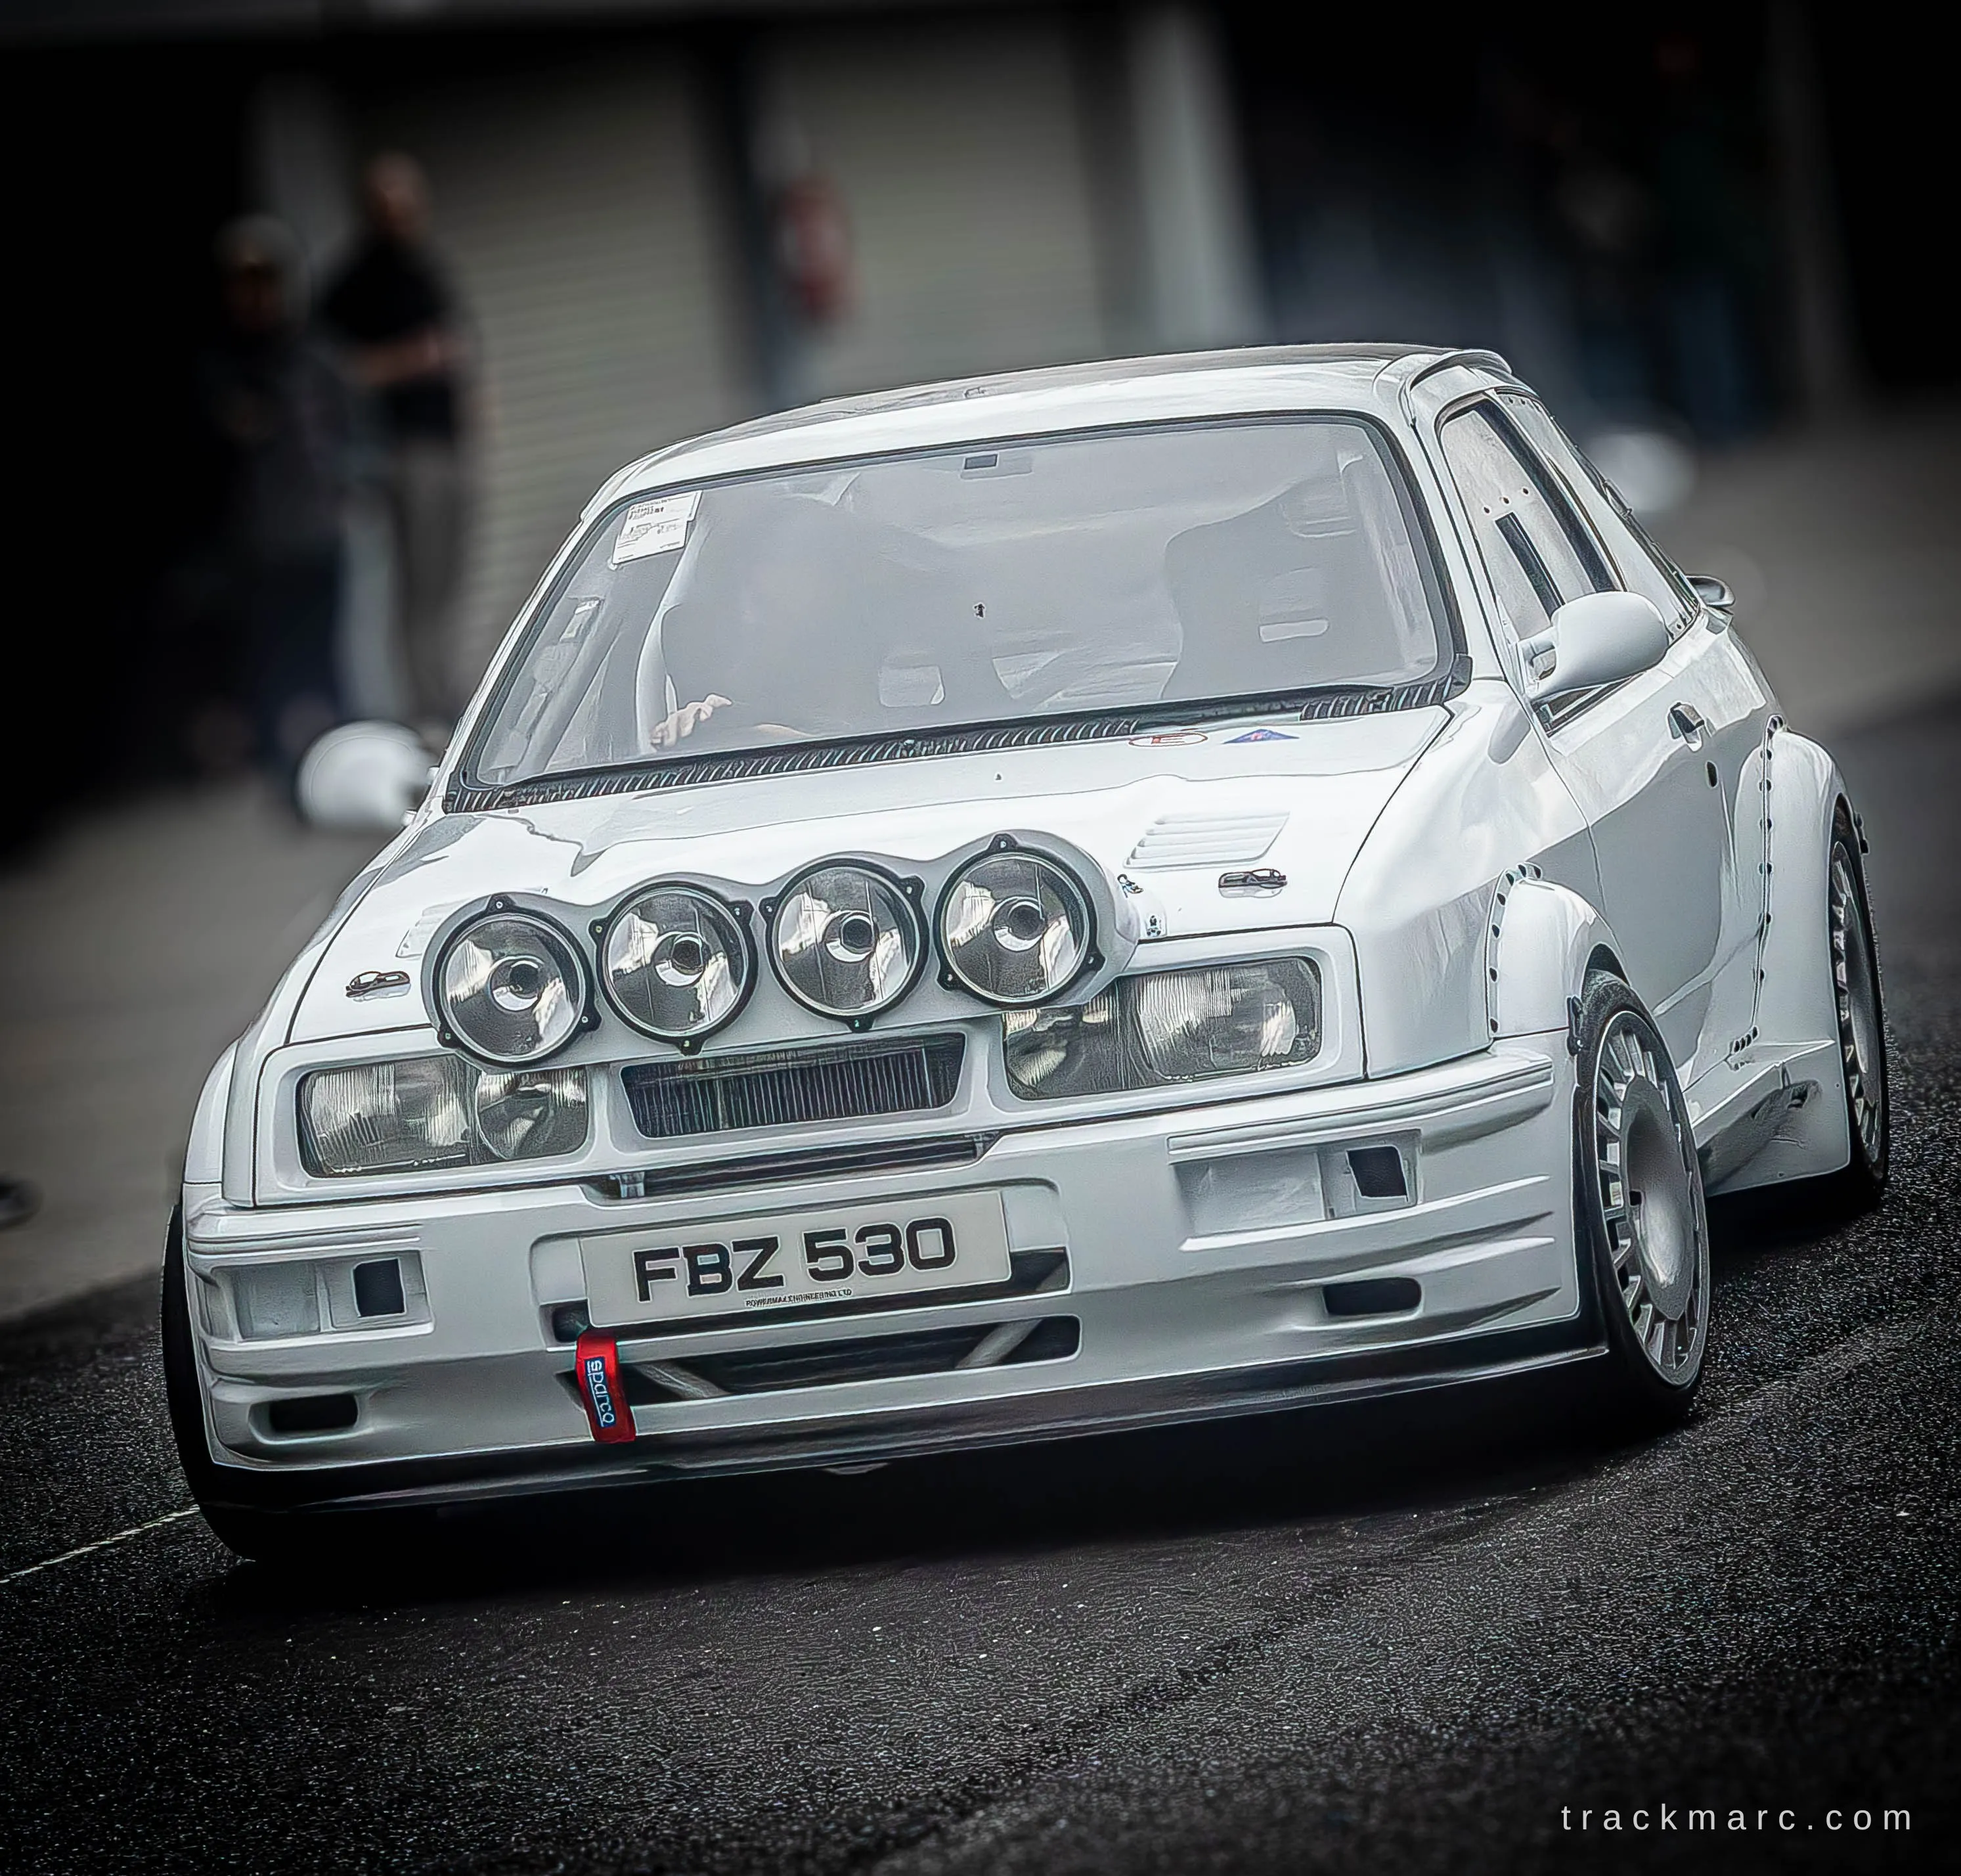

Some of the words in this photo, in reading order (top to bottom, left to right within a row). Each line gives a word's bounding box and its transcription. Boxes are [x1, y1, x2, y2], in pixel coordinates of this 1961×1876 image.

[633, 1236, 784, 1302] FBZ
[803, 1217, 956, 1282] 530
[838, 1289, 852, 1299] LTD
[588, 1360, 615, 1424] sparco
